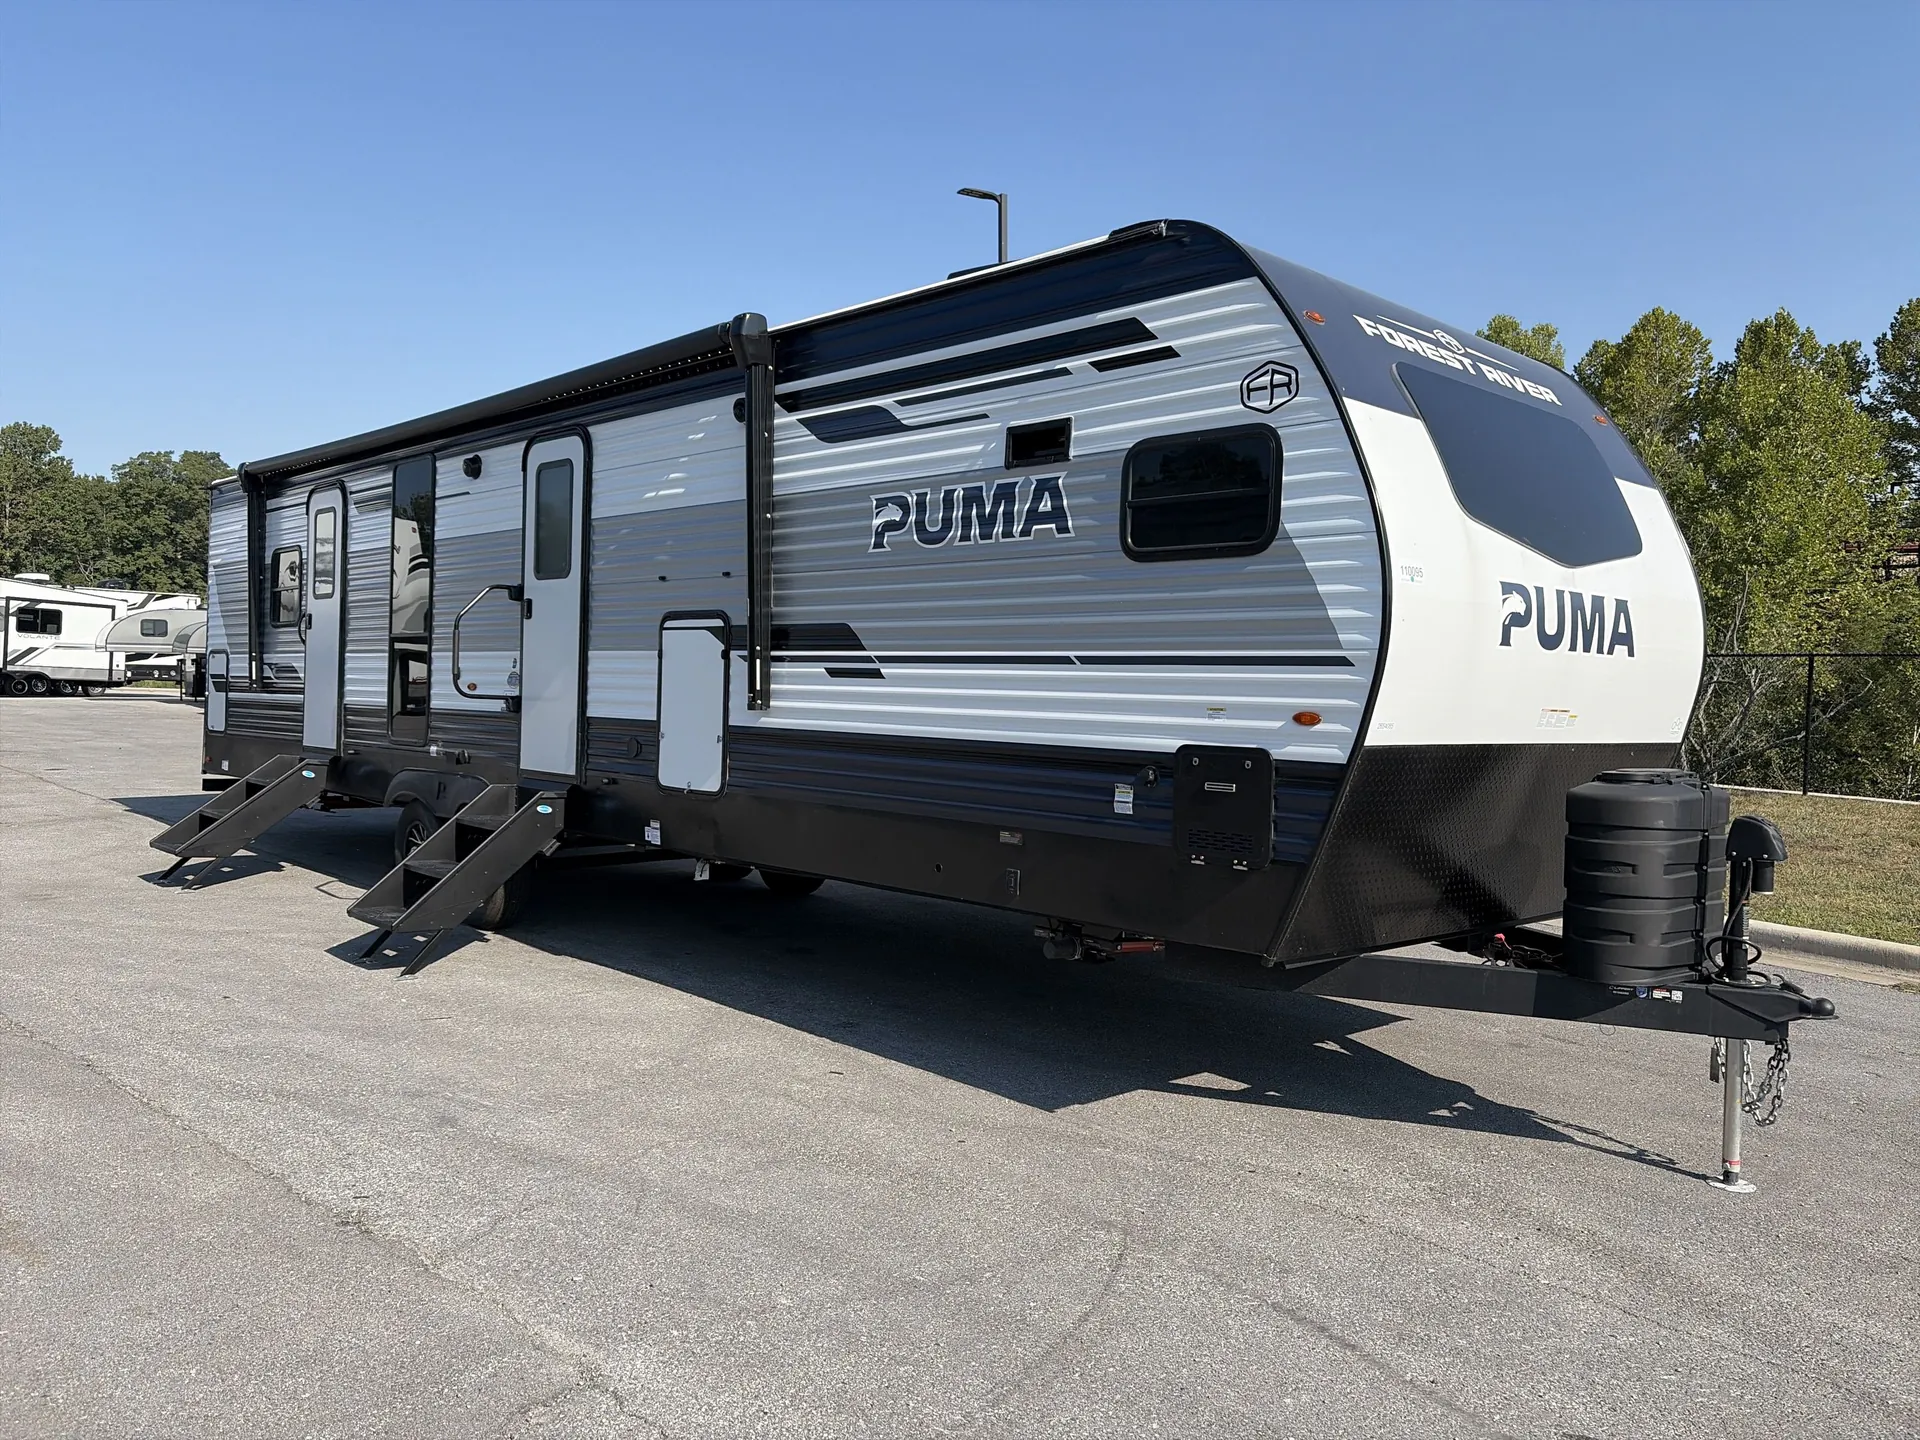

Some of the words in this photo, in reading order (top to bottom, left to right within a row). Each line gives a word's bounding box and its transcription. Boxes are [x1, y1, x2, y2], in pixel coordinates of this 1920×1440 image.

[1353, 314, 1476, 375] FOREST
[1476, 362, 1562, 406] RIVER
[868, 472, 1075, 553] PUMA
[1400, 565, 1424, 578] 110095
[1499, 581, 1636, 658] PUMA
